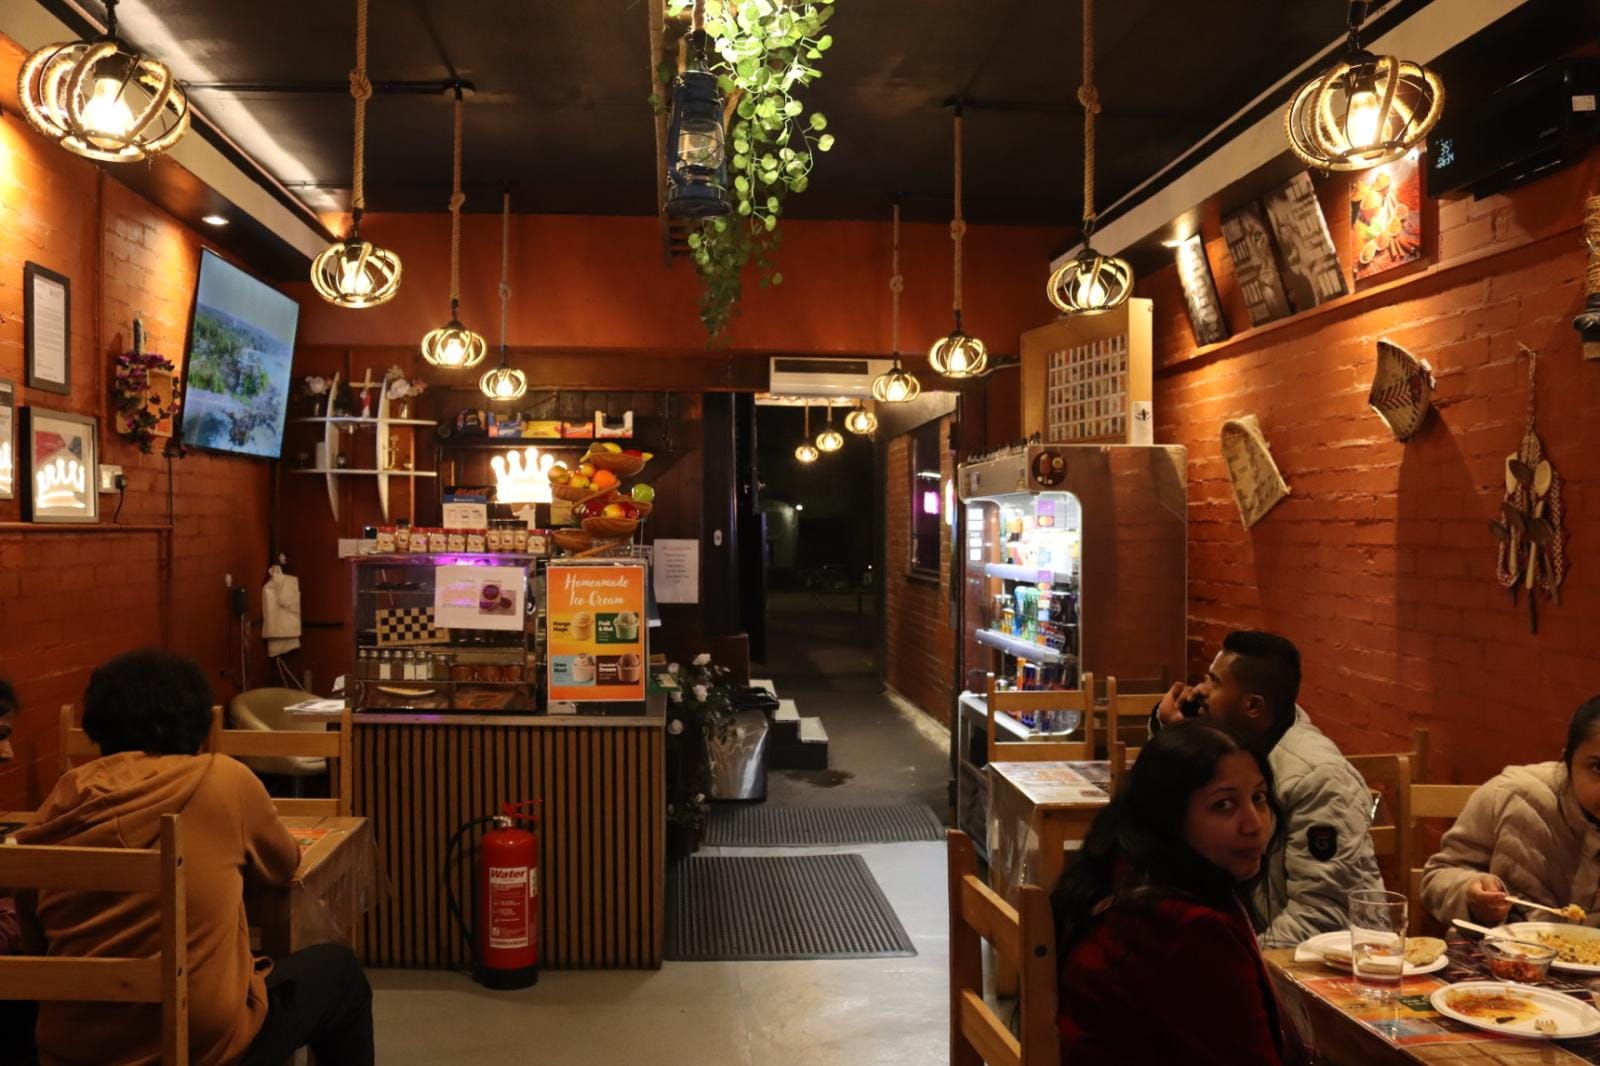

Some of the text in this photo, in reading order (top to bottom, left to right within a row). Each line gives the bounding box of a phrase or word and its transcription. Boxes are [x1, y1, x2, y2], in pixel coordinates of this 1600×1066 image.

[570, 591, 624, 607] Ice Cream
[491, 869, 525, 878] Water
